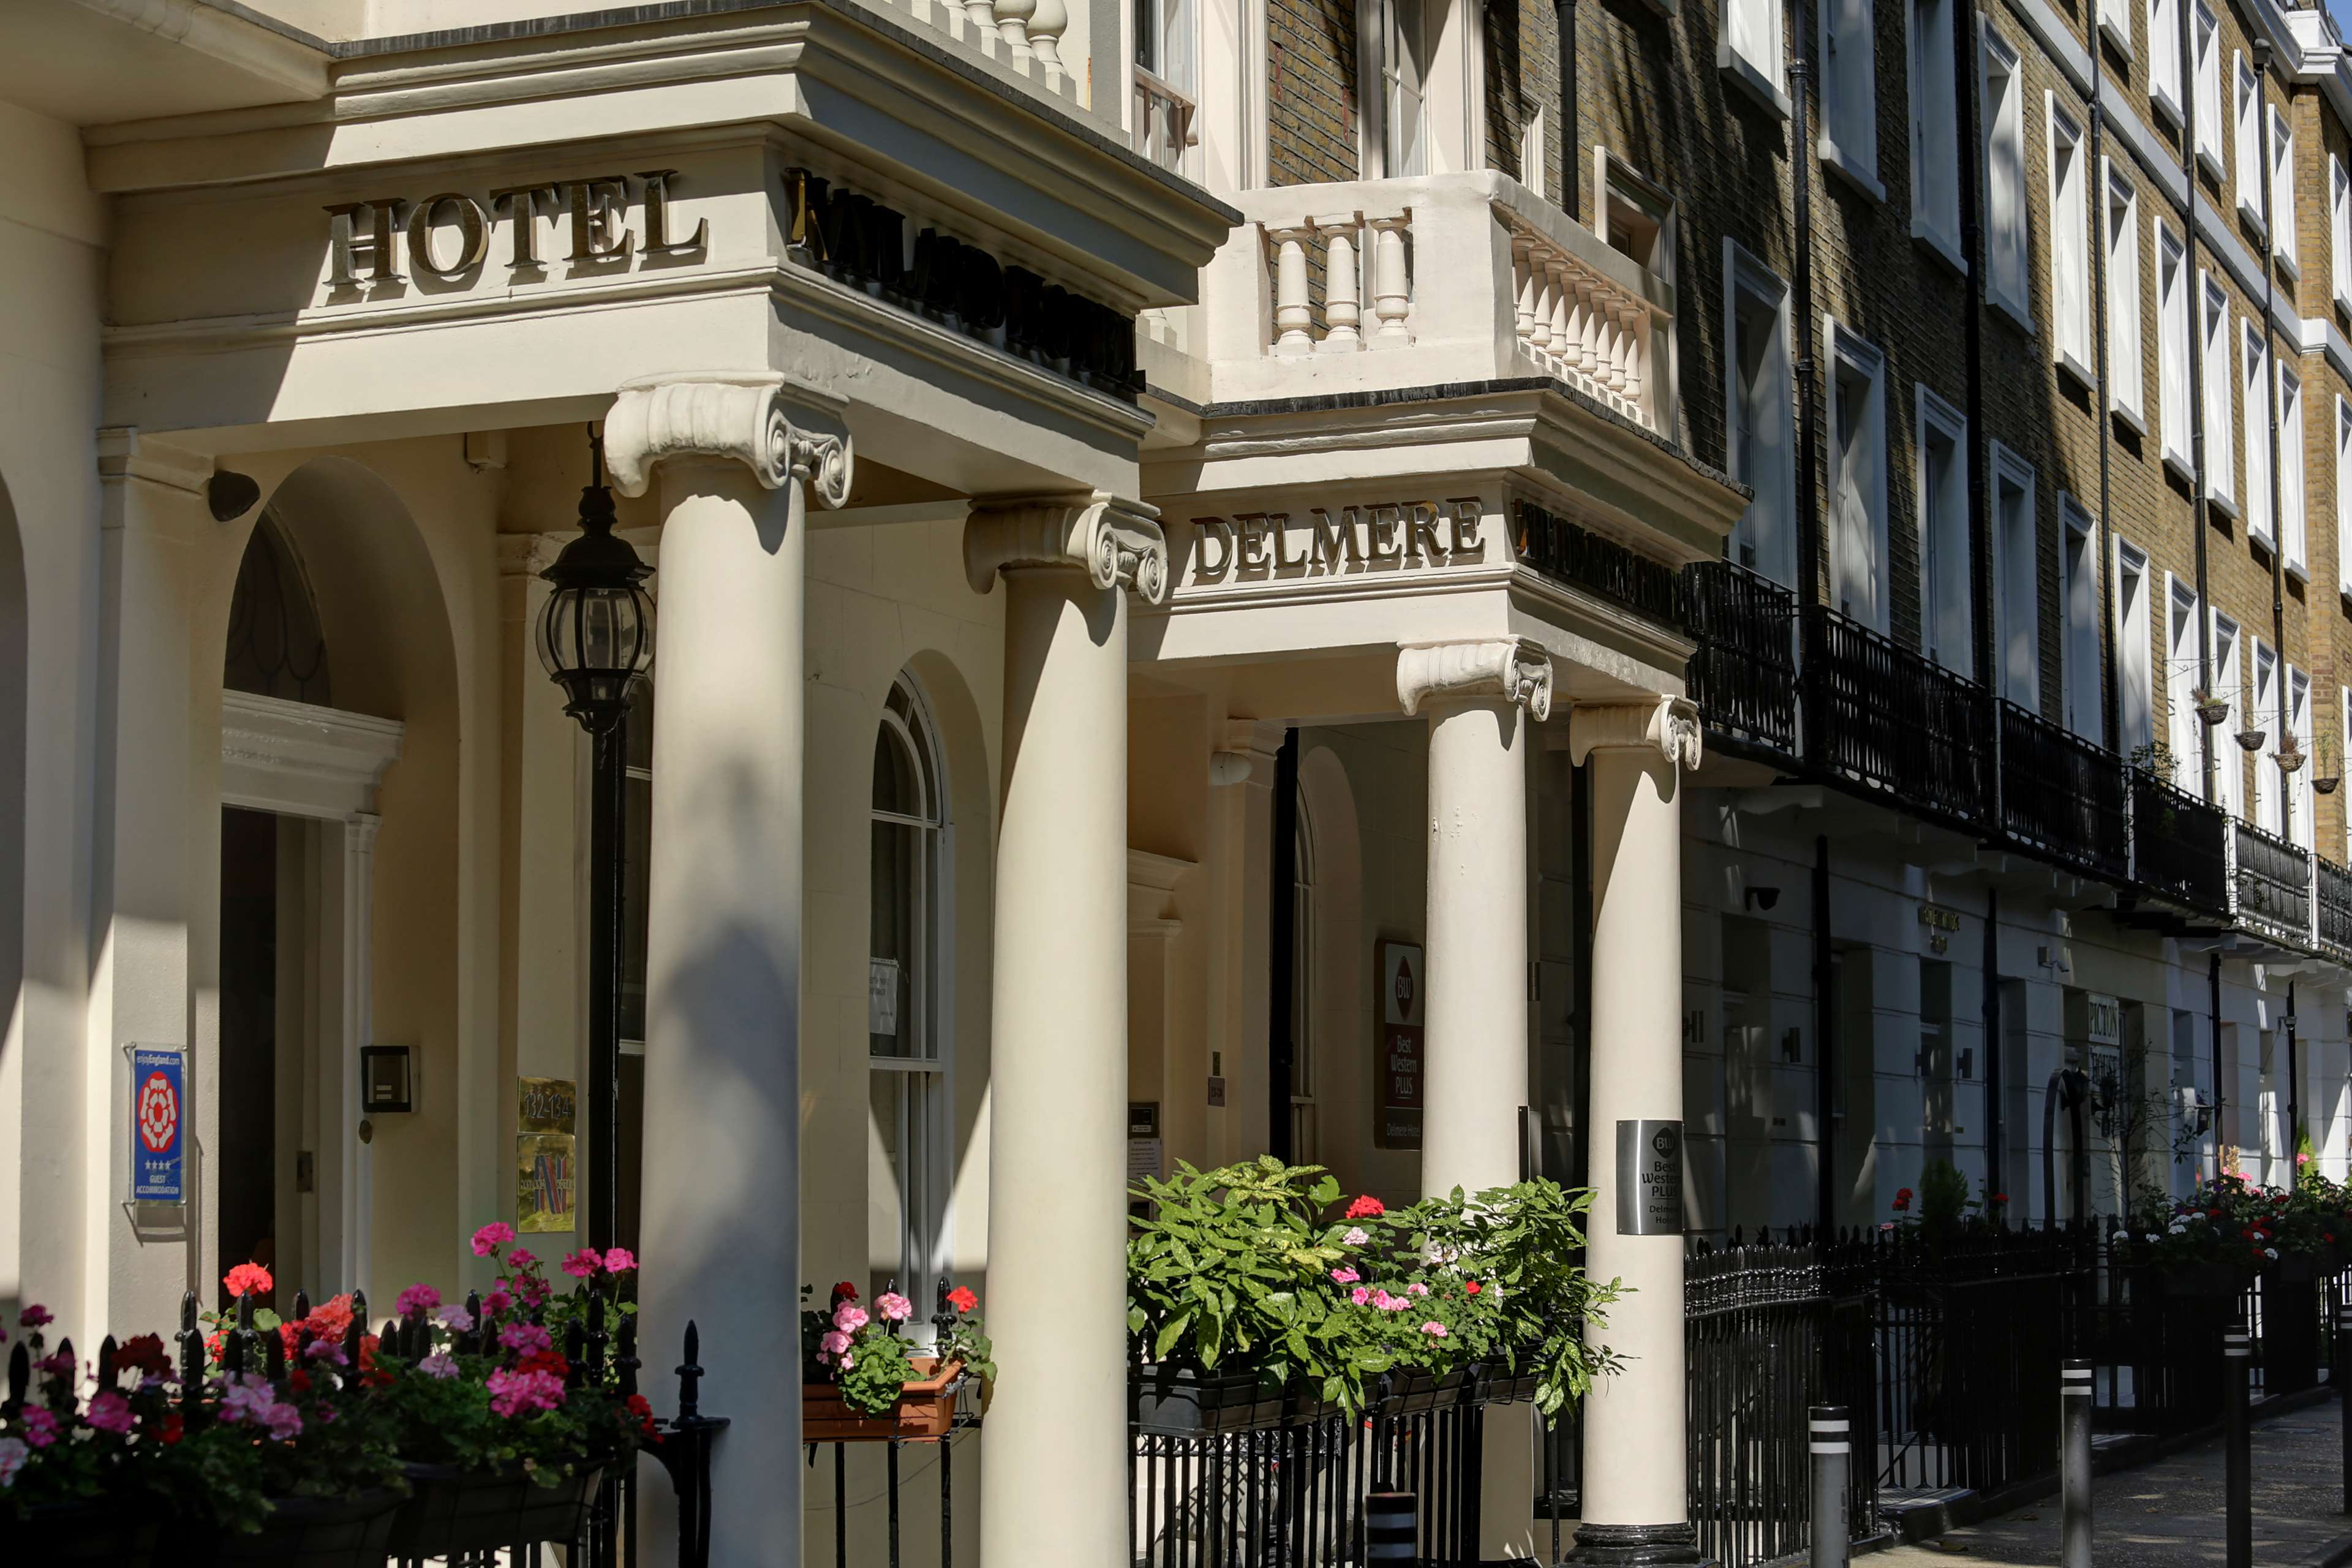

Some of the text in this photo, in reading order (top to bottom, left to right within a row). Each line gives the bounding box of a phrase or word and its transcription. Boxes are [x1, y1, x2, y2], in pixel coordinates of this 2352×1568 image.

[322, 169, 708, 285] HOTEL
[1190, 496, 1487, 575] DELMERE
[1398, 976, 1411, 998] BW
[2089, 1002, 2117, 1038] PICTON
[1397, 1035, 1411, 1053] Best
[1391, 1054, 1417, 1072] Western
[1396, 1076, 1412, 1094] PLUS
[525, 1093, 571, 1120] 132-134
[1656, 1137, 1675, 1149] BW
[1654, 1161, 1676, 1172] Best
[149, 1175, 166, 1183] GUEST
[137, 1185, 179, 1194] ACCOMMODATION
